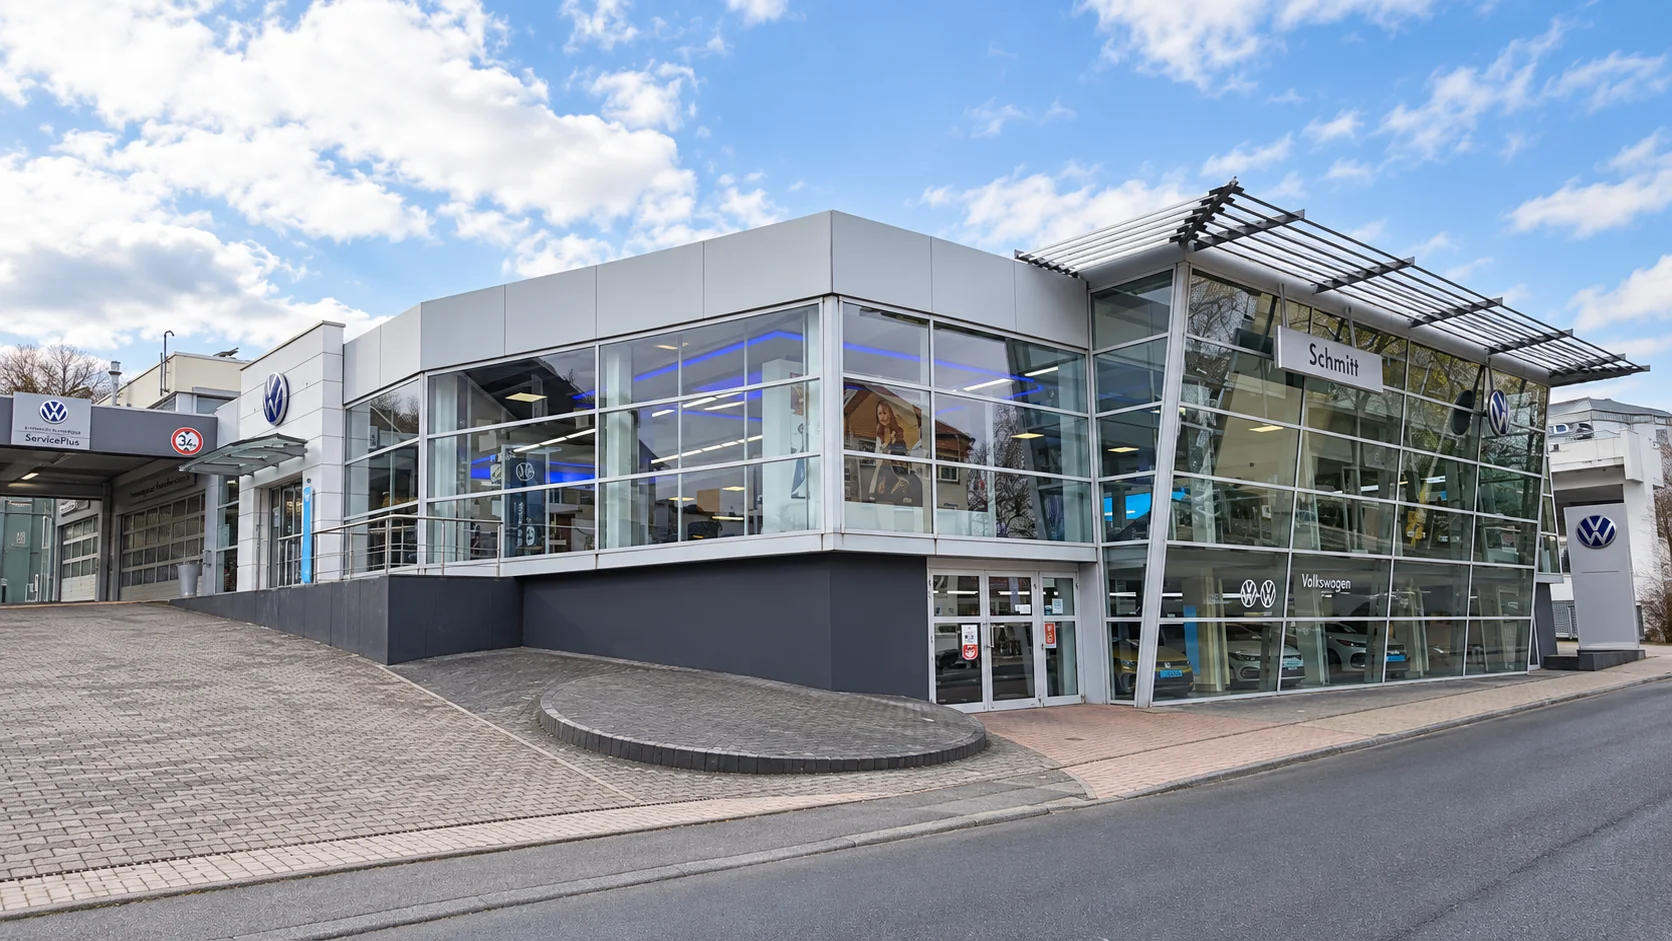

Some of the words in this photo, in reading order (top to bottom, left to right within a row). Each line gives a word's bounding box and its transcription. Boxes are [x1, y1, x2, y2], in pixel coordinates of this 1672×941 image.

[1309, 343, 1360, 377] Schmitt
[40, 400, 68, 423] VW
[263, 372, 287, 426] VW
[1488, 390, 1510, 436] VW
[25, 433, 80, 447] ServicePlus
[1576, 515, 1617, 549] VW
[1301, 573, 1351, 593] Volkswagen
